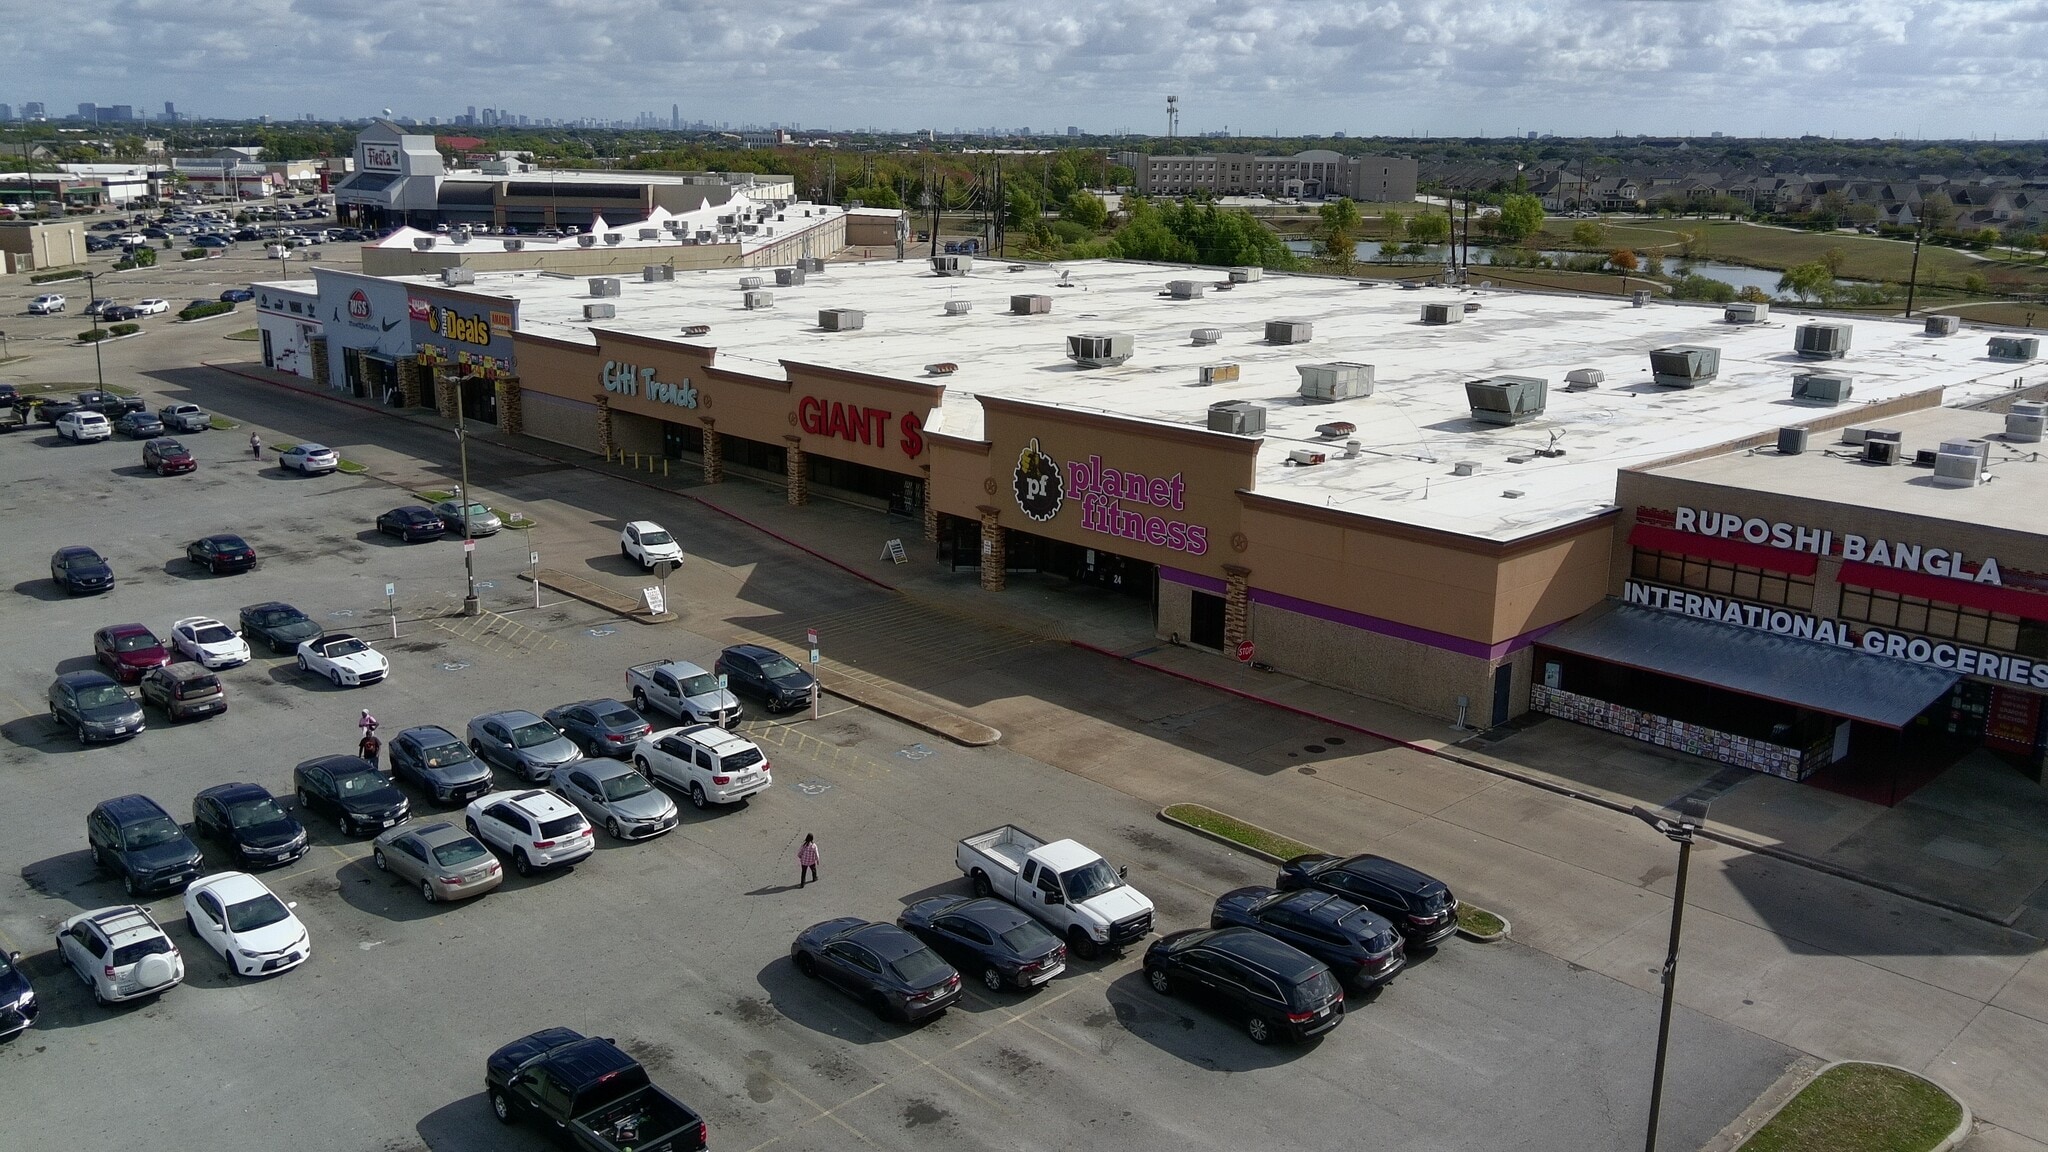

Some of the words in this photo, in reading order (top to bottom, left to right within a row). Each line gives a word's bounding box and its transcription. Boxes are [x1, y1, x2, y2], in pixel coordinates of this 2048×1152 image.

[367, 147, 392, 167] Fiesta
[350, 299, 367, 315] WSS
[447, 310, 490, 346] Deals
[641, 367, 698, 409] Trends
[799, 395, 892, 448] GIANT
[900, 411, 923, 459] $
[1026, 474, 1048, 500] pf
[1067, 454, 1186, 511] planet
[1081, 493, 1208, 556] fitness
[1675, 506, 1832, 556] RUPOSHI
[1842, 534, 2002, 586] BANGLA
[1113, 574, 1122, 585] 24
[1239, 646, 1253, 656] STOP
[1624, 581, 1854, 648] INTERNATIONAL
[1862, 630, 2048, 688] GROCERIES
